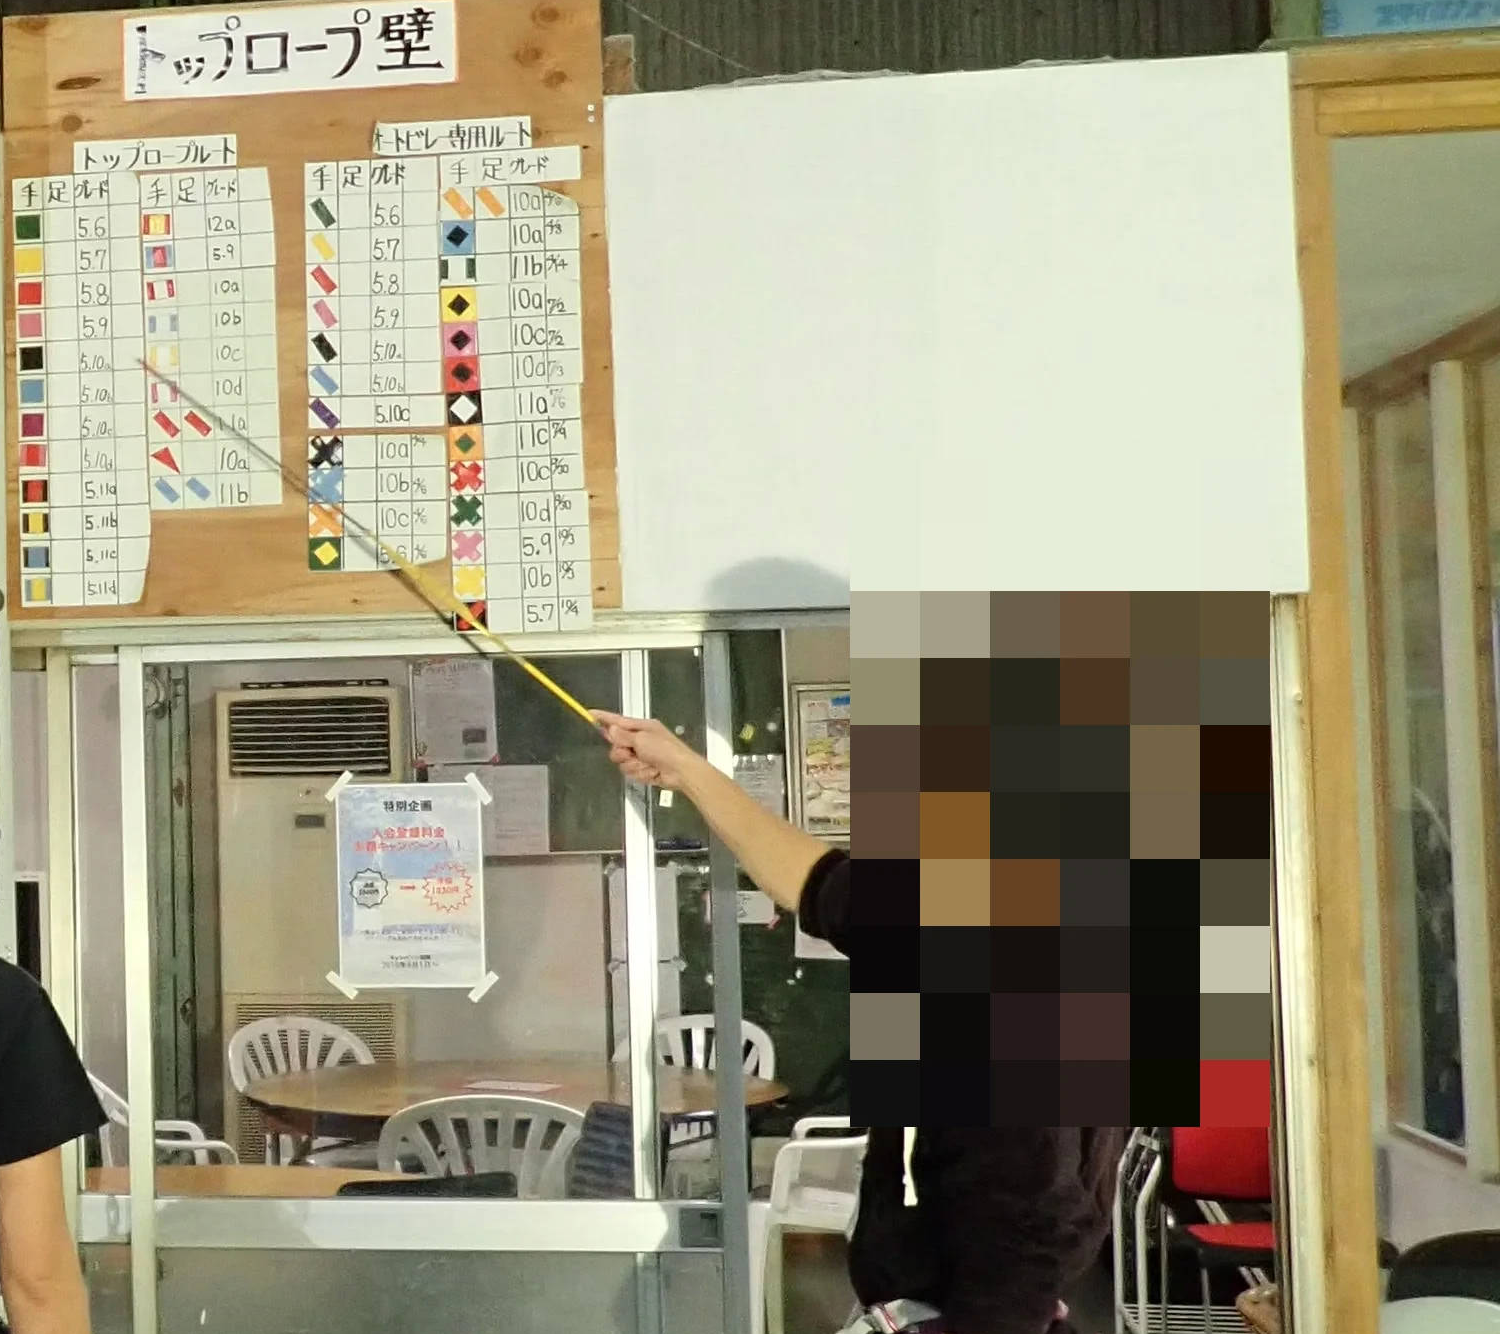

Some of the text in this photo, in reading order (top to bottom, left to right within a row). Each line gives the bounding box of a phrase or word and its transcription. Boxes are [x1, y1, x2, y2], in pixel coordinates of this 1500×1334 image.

[135, 7, 445, 95] トップロープ壁
[84, 137, 235, 170] トップロープルート
[312, 165, 332, 191] 手
[343, 166, 365, 188] 足
[449, 158, 469, 184] 手
[482, 157, 507, 181] 足
[21, 183, 39, 207] 手
[48, 181, 72, 203] 足
[147, 178, 167, 206] 手
[178, 177, 197, 203] 足
[512, 192, 541, 212] 10a
[207, 215, 236, 233] 12a
[373, 204, 400, 226] 5.6
[77, 217, 106, 238] 5.6
[512, 224, 543, 245] 10a
[79, 249, 107, 270] 5.7
[212, 243, 234, 260] 5.9
[373, 238, 400, 260] 5.7
[512, 255, 542, 277] 11b
[81, 283, 109, 305] 5.8
[214, 280, 240, 294] 10a
[372, 273, 400, 295] 5.8
[512, 289, 542, 311] 10a
[83, 317, 108, 338] 5.9
[214, 309, 242, 327] 10b
[373, 308, 400, 329] 5.9
[513, 324, 546, 346] 10c
[215, 345, 243, 362] 10c
[215, 378, 243, 396] 10d
[518, 392, 548, 415] 11a
[518, 426, 548, 450] 11c
[220, 447, 249, 471] 10a
[380, 442, 409, 459] 10a
[380, 472, 409, 493] 10b
[519, 460, 551, 483] 10c
[220, 483, 249, 504] 11b
[381, 507, 409, 530] 10c
[521, 498, 551, 523] 10d
[522, 532, 552, 556] 5.9
[523, 565, 551, 591] 10b
[527, 603, 554, 623] 5.7
